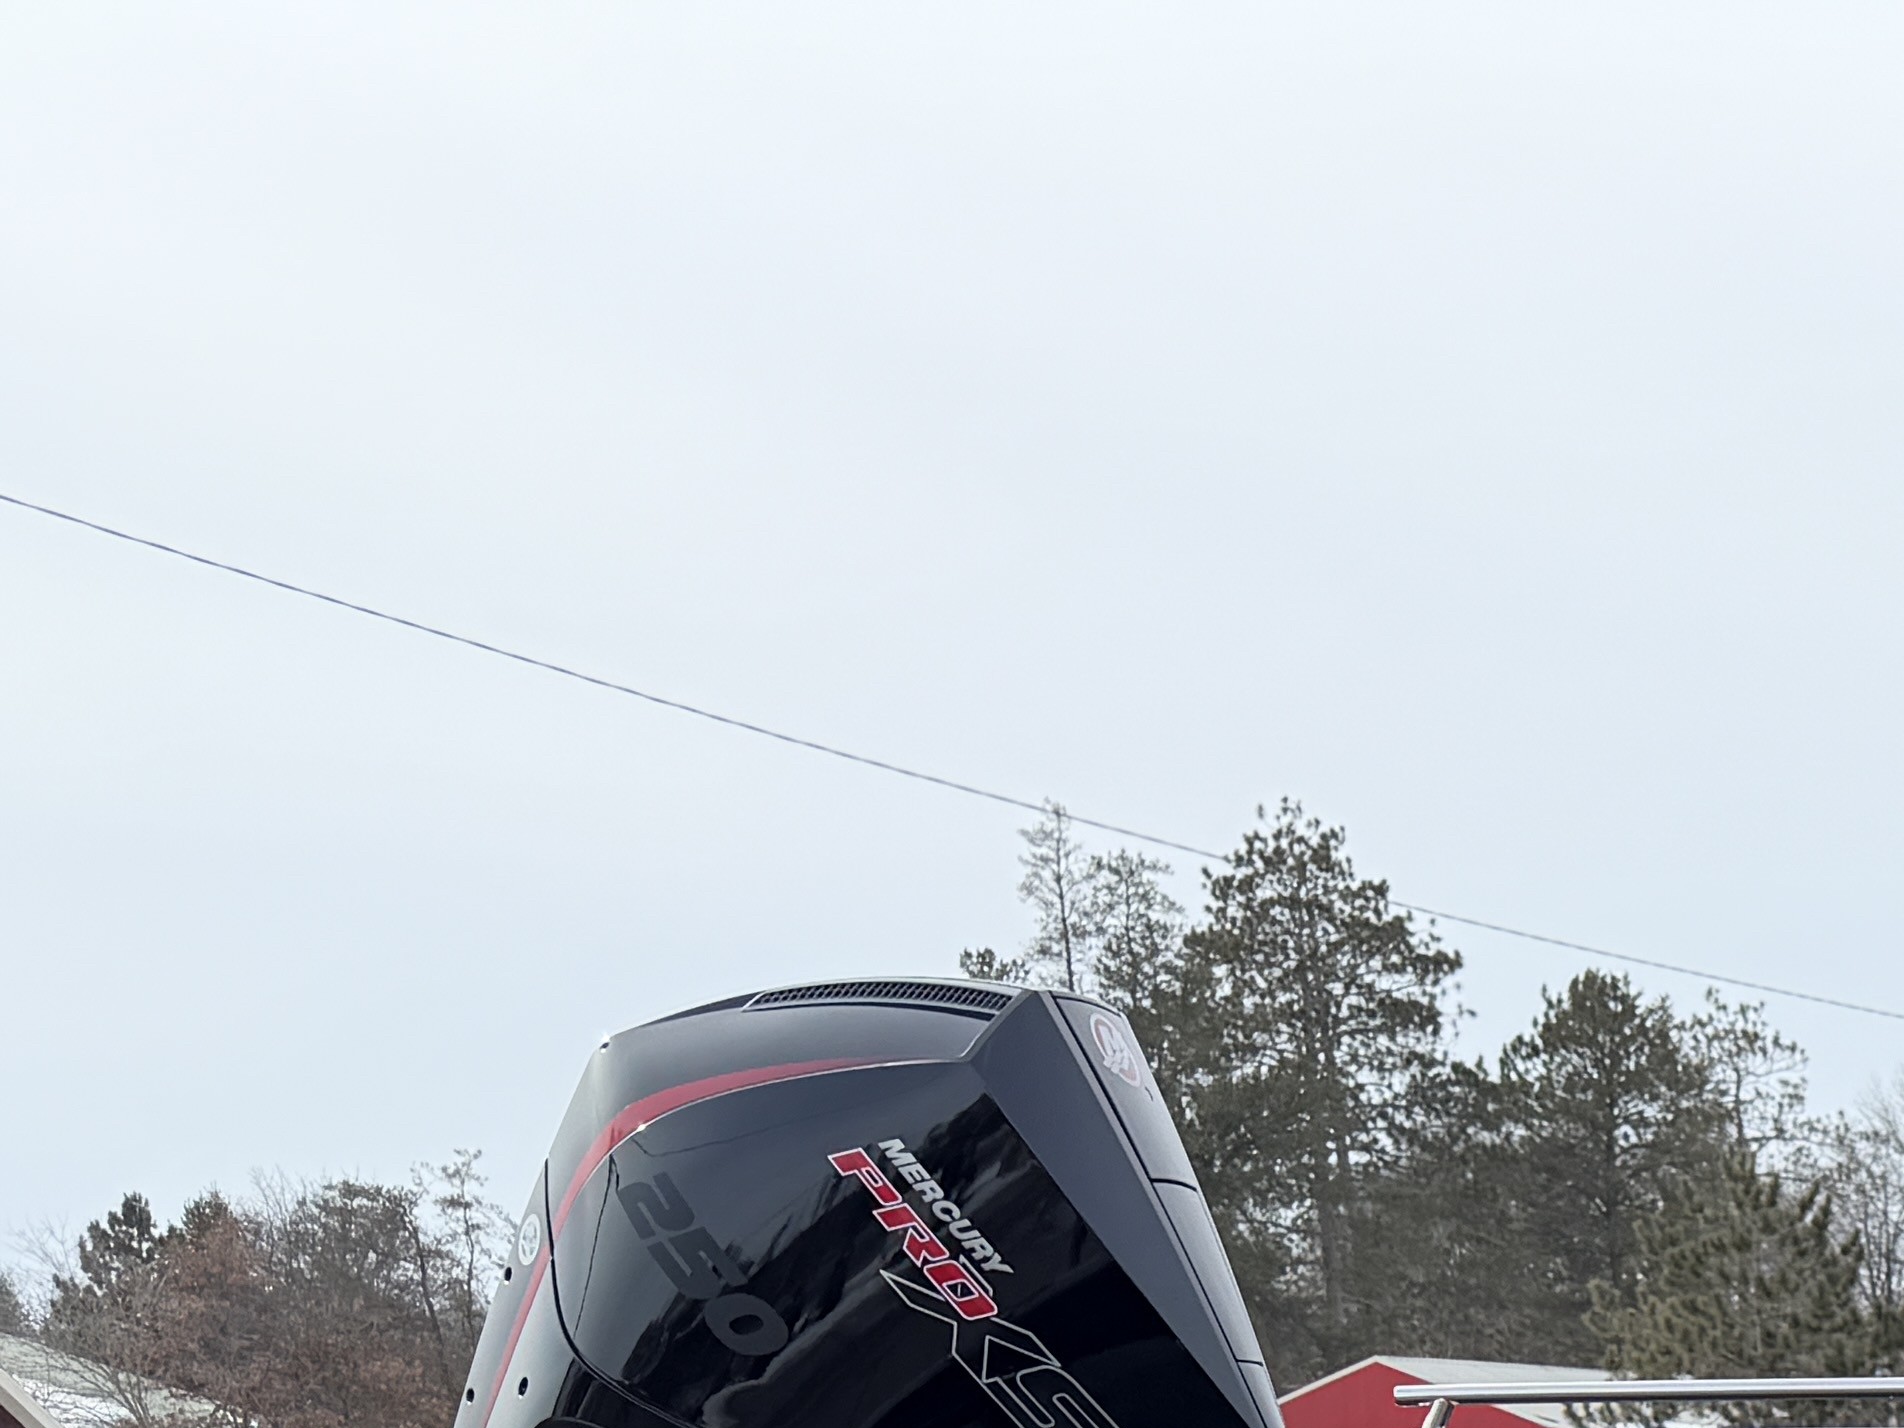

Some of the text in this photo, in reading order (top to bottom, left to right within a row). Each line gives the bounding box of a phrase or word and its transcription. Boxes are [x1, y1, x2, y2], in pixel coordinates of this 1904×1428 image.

[616, 1171, 790, 1357] 250
[827, 1147, 998, 1320] PRO
[878, 1138, 1014, 1273] MERCURY
